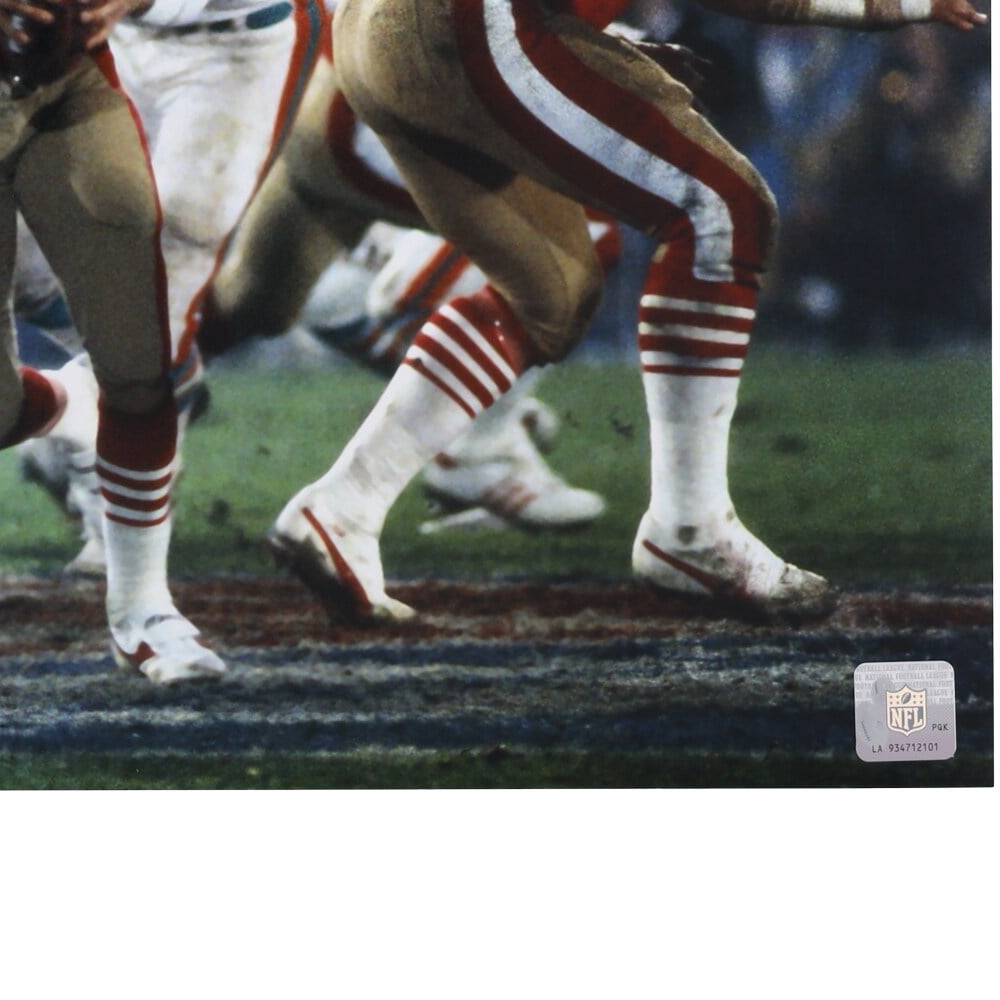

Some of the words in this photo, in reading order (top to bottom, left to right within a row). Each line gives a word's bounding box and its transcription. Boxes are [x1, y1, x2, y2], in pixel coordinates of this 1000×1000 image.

[889, 707, 923, 731] NFL
[932, 723, 949, 731] PQK
[872, 744, 883, 753] LA
[888, 742, 938, 752] 934712101
